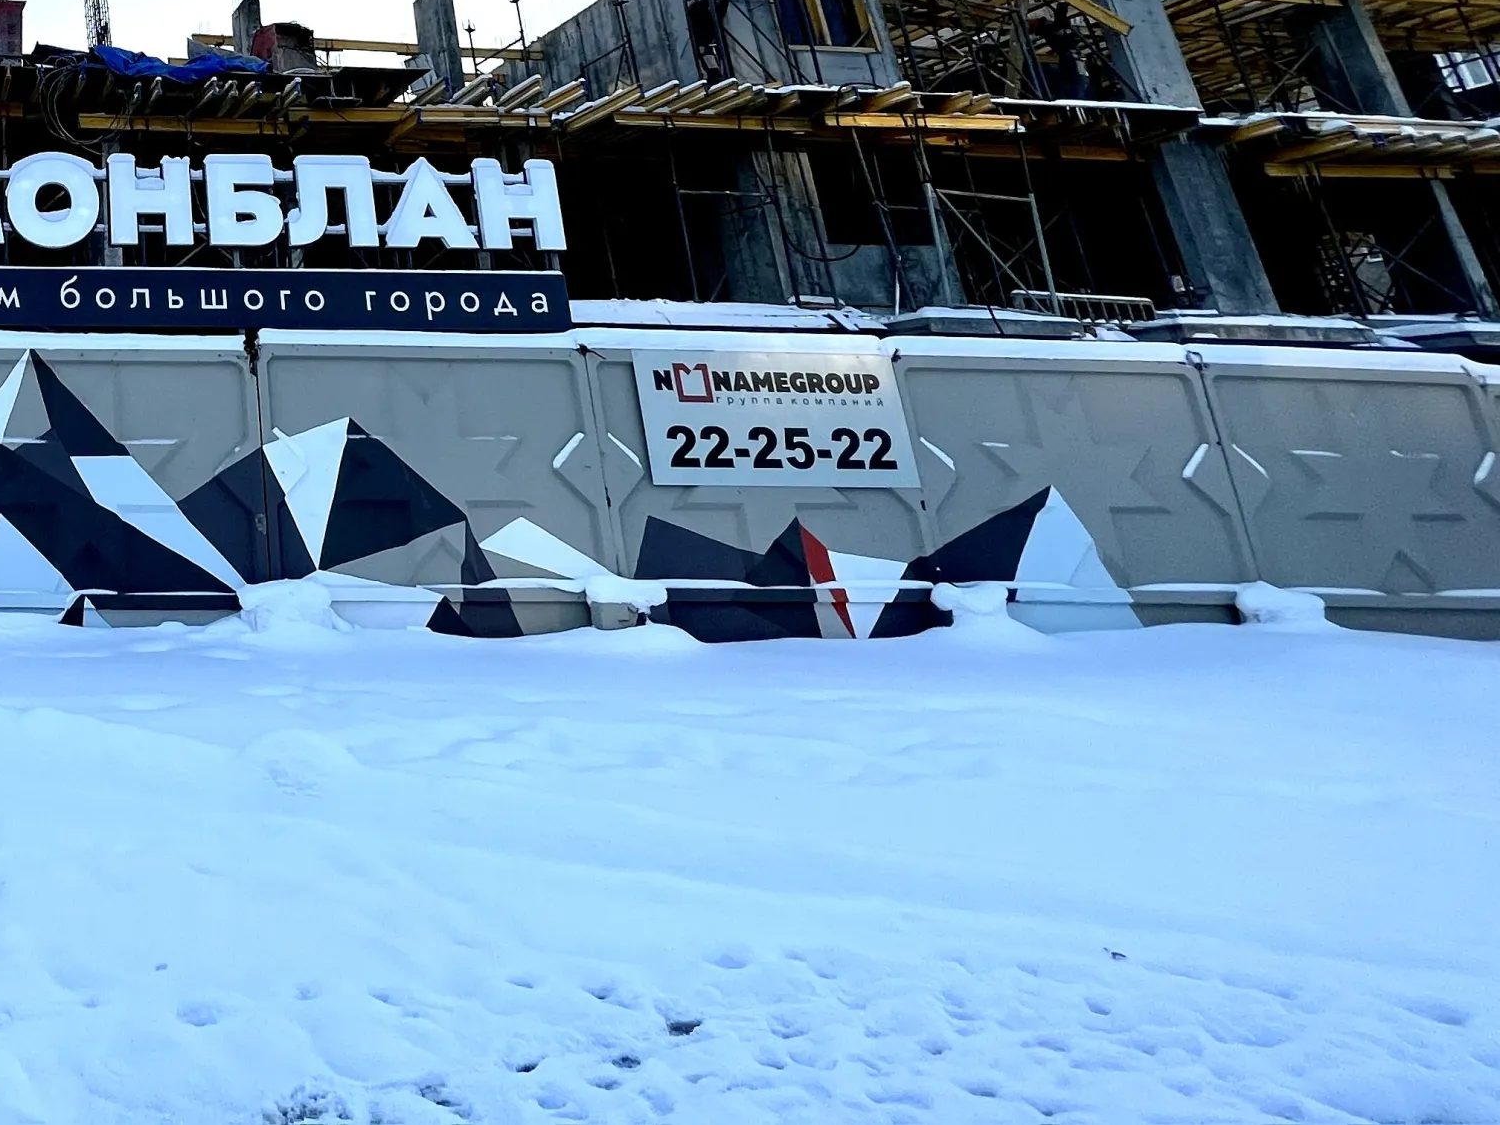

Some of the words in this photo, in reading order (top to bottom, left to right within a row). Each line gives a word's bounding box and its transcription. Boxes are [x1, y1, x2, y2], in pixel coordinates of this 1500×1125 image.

[59, 276, 327, 312] большого
[364, 286, 551, 322] города
[716, 395, 783, 407] группа
[790, 396, 884, 407] компаний
[666, 424, 898, 470] 22-25-22
